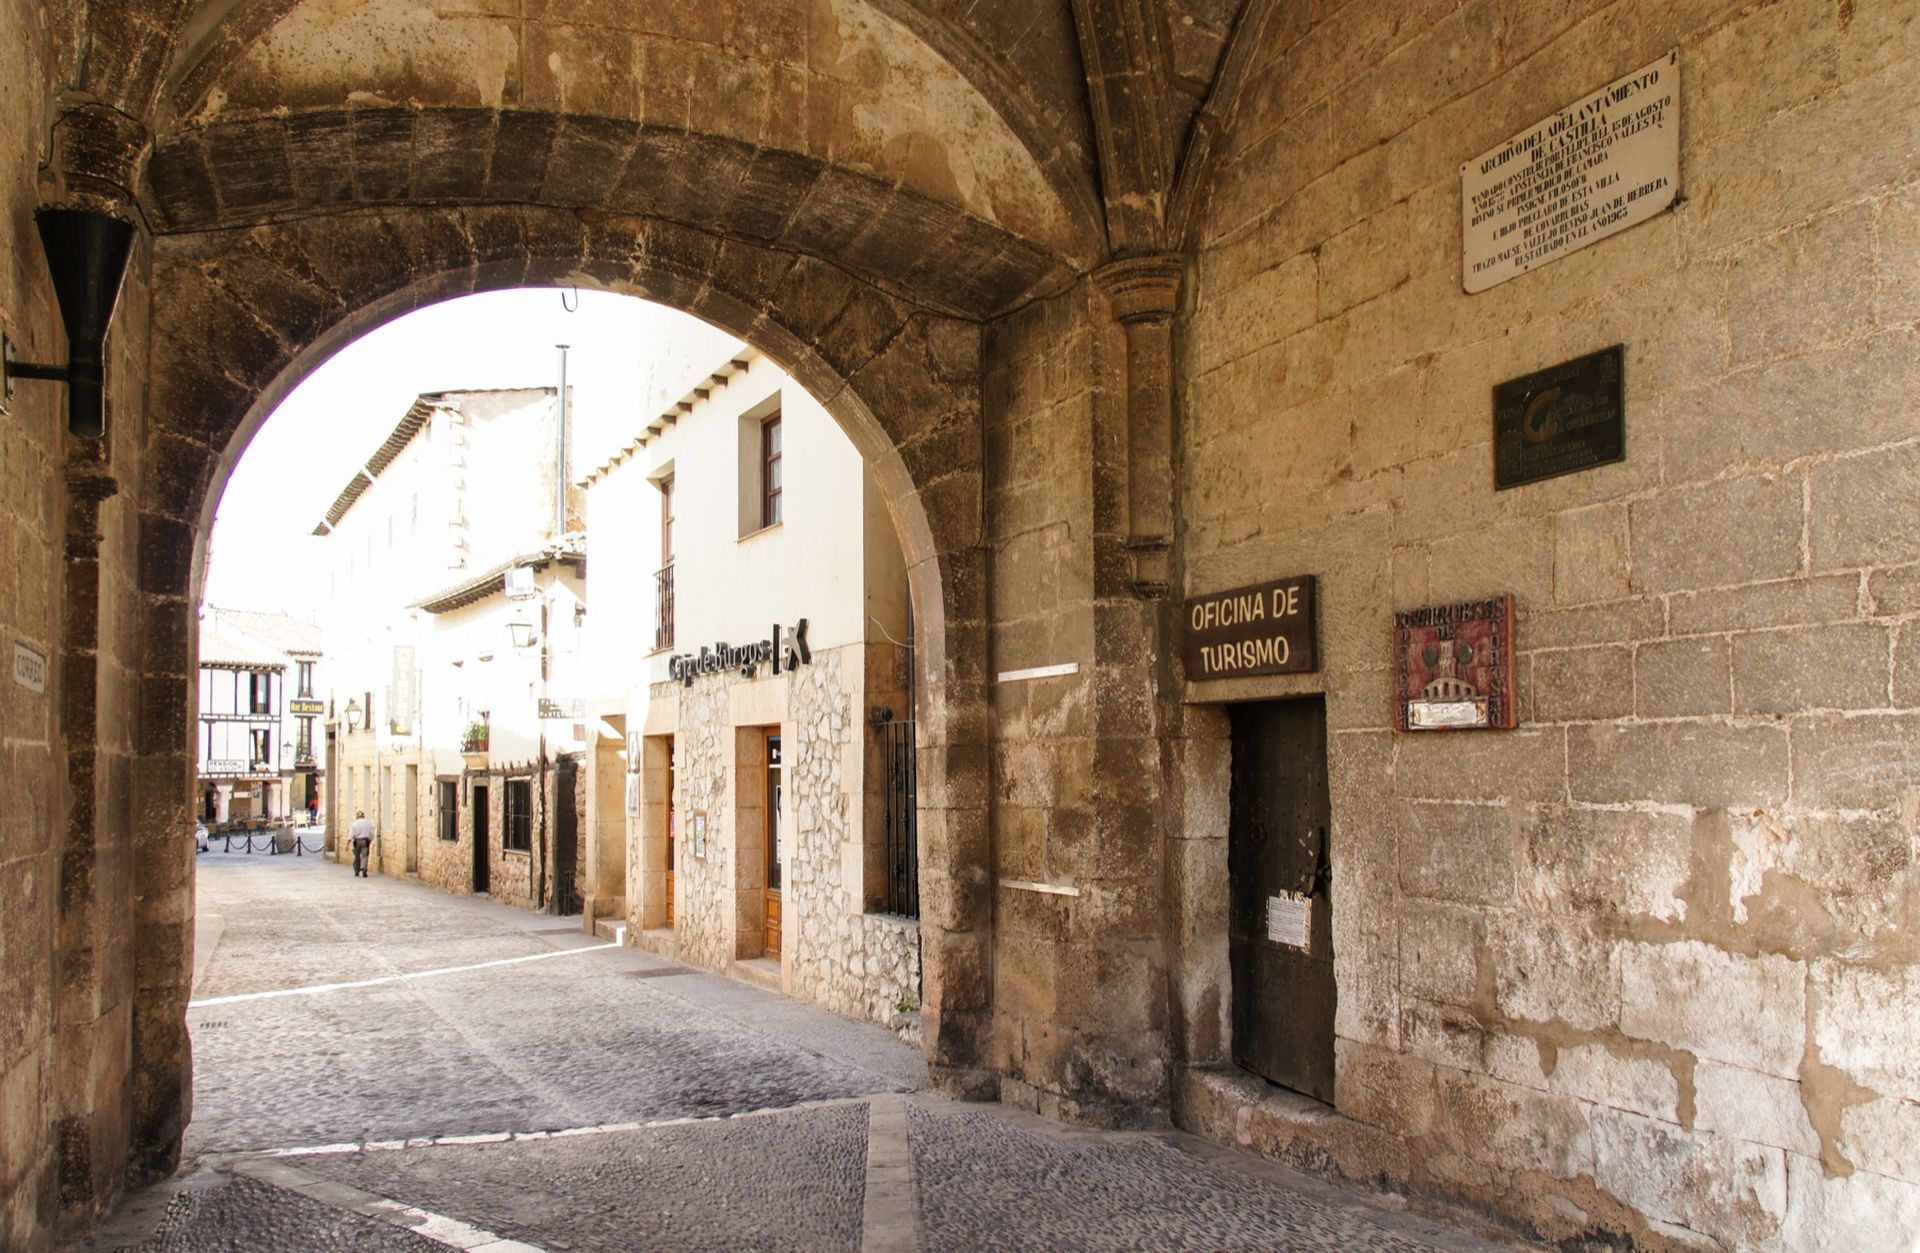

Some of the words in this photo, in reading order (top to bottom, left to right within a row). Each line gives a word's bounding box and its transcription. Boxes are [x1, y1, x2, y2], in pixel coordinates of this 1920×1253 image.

[1480, 141, 1522, 175] ARCHIVO
[1523, 128, 1545, 151] DEL
[1547, 68, 1658, 138] ADELANTAMIENTO
[1503, 159, 1542, 189] CONSTRUIR
[1544, 150, 1560, 167] POR
[1561, 134, 1589, 158] FELIPE
[1598, 125, 1608, 139] EL
[1612, 118, 1620, 132] 15
[1621, 113, 1633, 128] DE
[1635, 94, 1670, 121] AGOSTO
[1531, 143, 1546, 162] DE
[1549, 111, 1607, 153] CASTILLA
[1554, 159, 1564, 173] DE
[1565, 135, 1612, 167] FRANCISCO
[1614, 116, 1648, 143] VALLES
[1651, 108, 1664, 125] EL
[1471, 206, 1494, 227] DIVINO
[1507, 187, 1533, 209] PRIMER
[1564, 166, 1574, 180] DE
[1499, 220, 1516, 237] HIJO
[1518, 200, 1557, 228] PRECLARO
[1559, 195, 1569, 208] DE
[1571, 183, 1592, 203] ESTA
[1595, 170, 1619, 191] VILLA
[1548, 172, 1586, 200] FILOSOFO
[1523, 226, 1557, 251] VALLEJO
[1559, 211, 1587, 235] REVISO
[1589, 201, 1611, 220] JUAN
[1613, 194, 1624, 209] DE
[1627, 174, 1667, 203] HERRERA
[1523, 225, 1533, 239] DE
[1535, 198, 1588, 233] COVARRUBIAS
[1514, 235, 1563, 267] RESTAURADO
[1565, 229, 1576, 244] EN
[1578, 223, 1588, 238] EL
[1192, 592, 1265, 631] OFICINA
[1272, 585, 1300, 619] DE
[669, 653, 694, 688] Caja
[695, 646, 715, 674] de
[714, 640, 771, 680] Burgos
[1200, 636, 1290, 673] TURISMO
